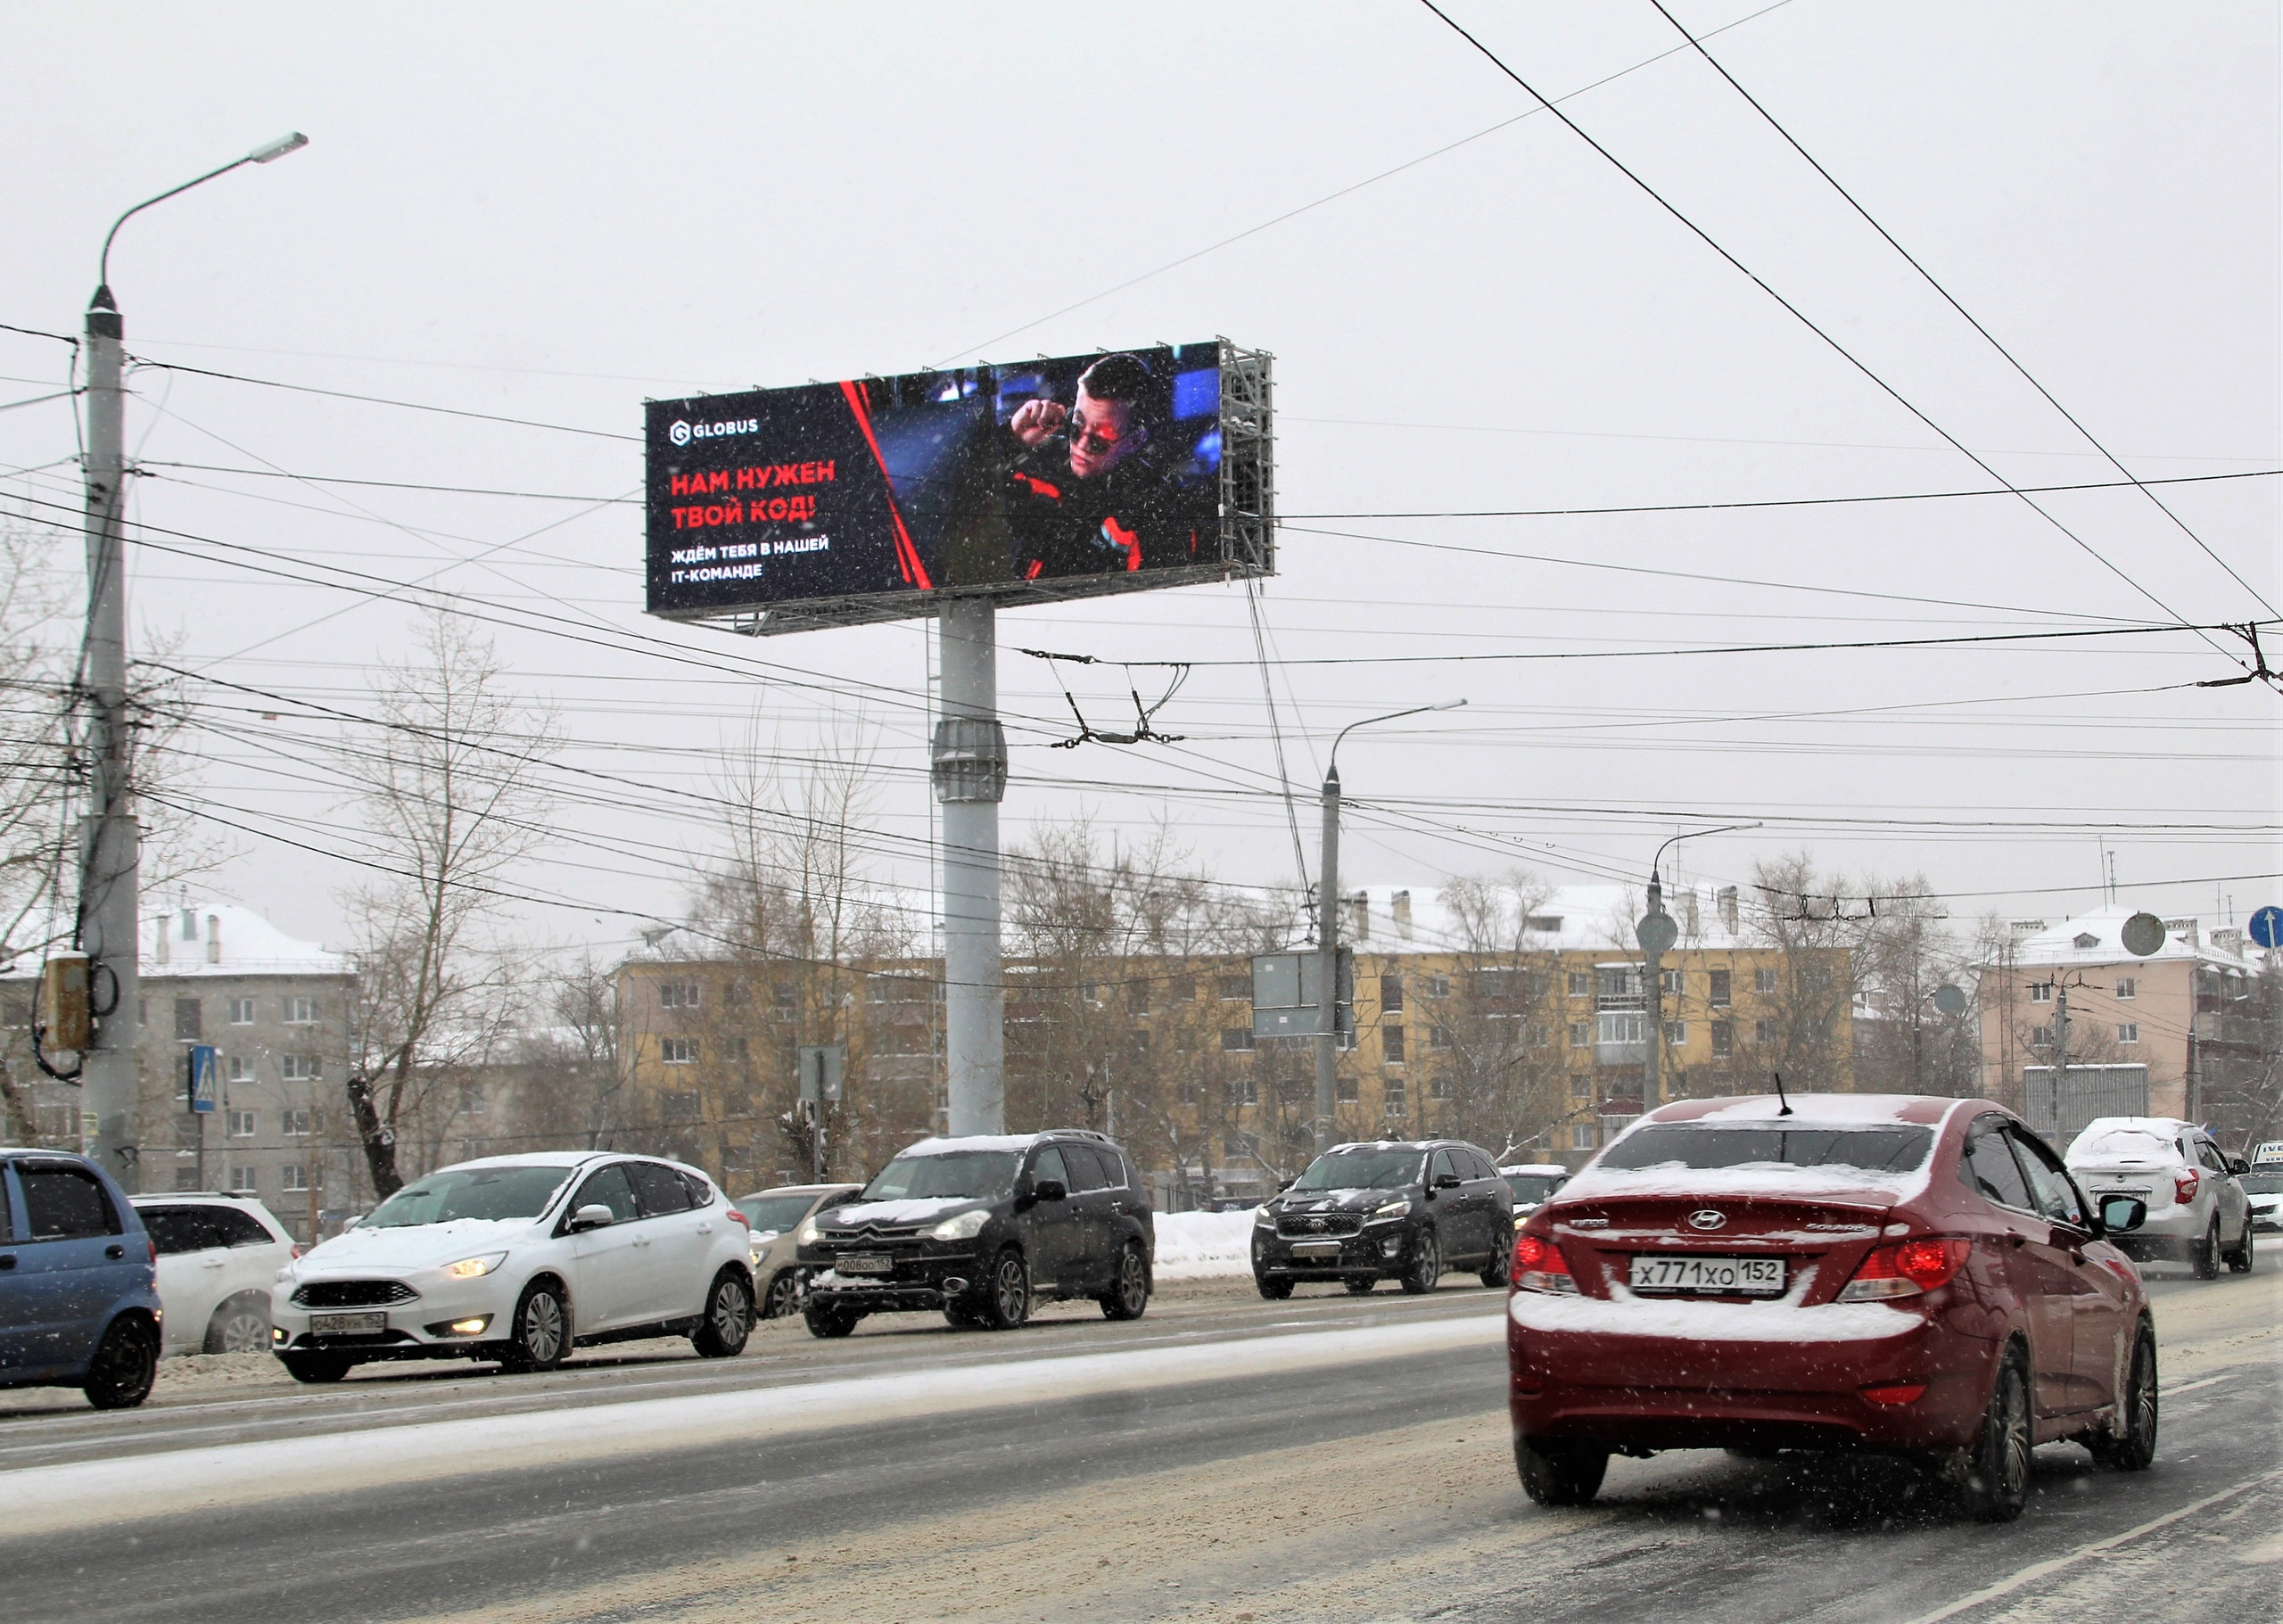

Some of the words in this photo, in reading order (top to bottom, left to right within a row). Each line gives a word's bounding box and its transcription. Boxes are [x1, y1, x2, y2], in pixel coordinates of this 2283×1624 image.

[693, 419, 758, 438] GLOBUS
[671, 470, 729, 496] НАМ
[737, 460, 835, 489] НУЖЕН
[671, 498, 743, 529] ТВОЙ
[750, 496, 815, 523] КОД!
[671, 545, 717, 564] ЖДЁМ
[720, 541, 757, 558] ТЕБЯ
[760, 542, 771, 556] В
[773, 535, 829, 554] НАШЕЙ
[671, 564, 762, 583] IT-КОМАНДЕ
[1741, 1262, 1777, 1281] 152
